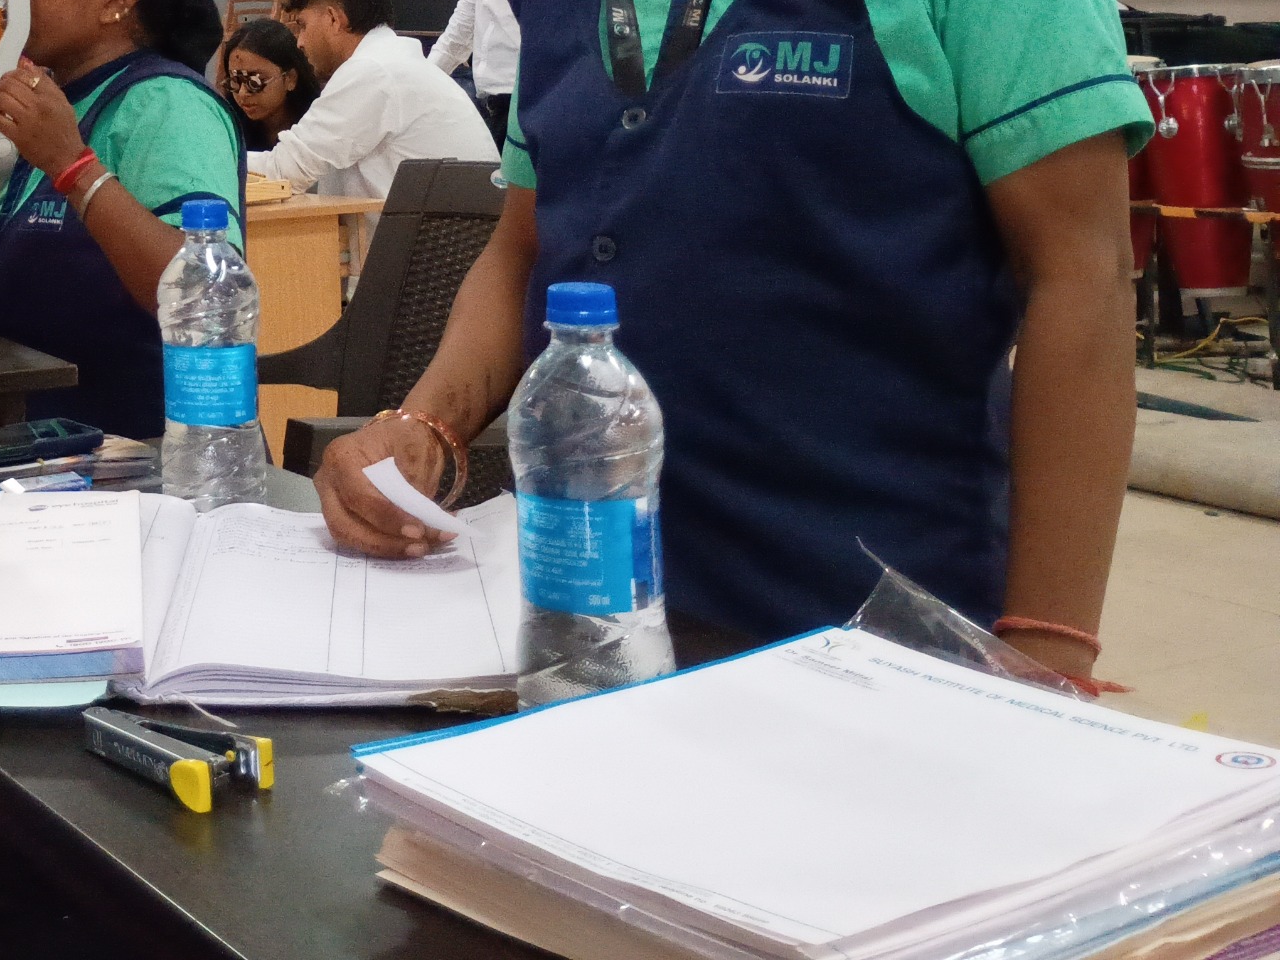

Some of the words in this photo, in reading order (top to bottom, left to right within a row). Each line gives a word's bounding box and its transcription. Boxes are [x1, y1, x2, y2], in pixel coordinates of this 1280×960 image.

[775, 41, 841, 74] MJ
[774, 74, 838, 87] SOLANKI
[40, 200, 67, 218] MJ
[921, 674, 985, 696] INSTITUTE
[986, 692, 1006, 701] OF
[1006, 698, 1066, 719] MEDICAL
[1069, 715, 1132, 736] SCIENCE
